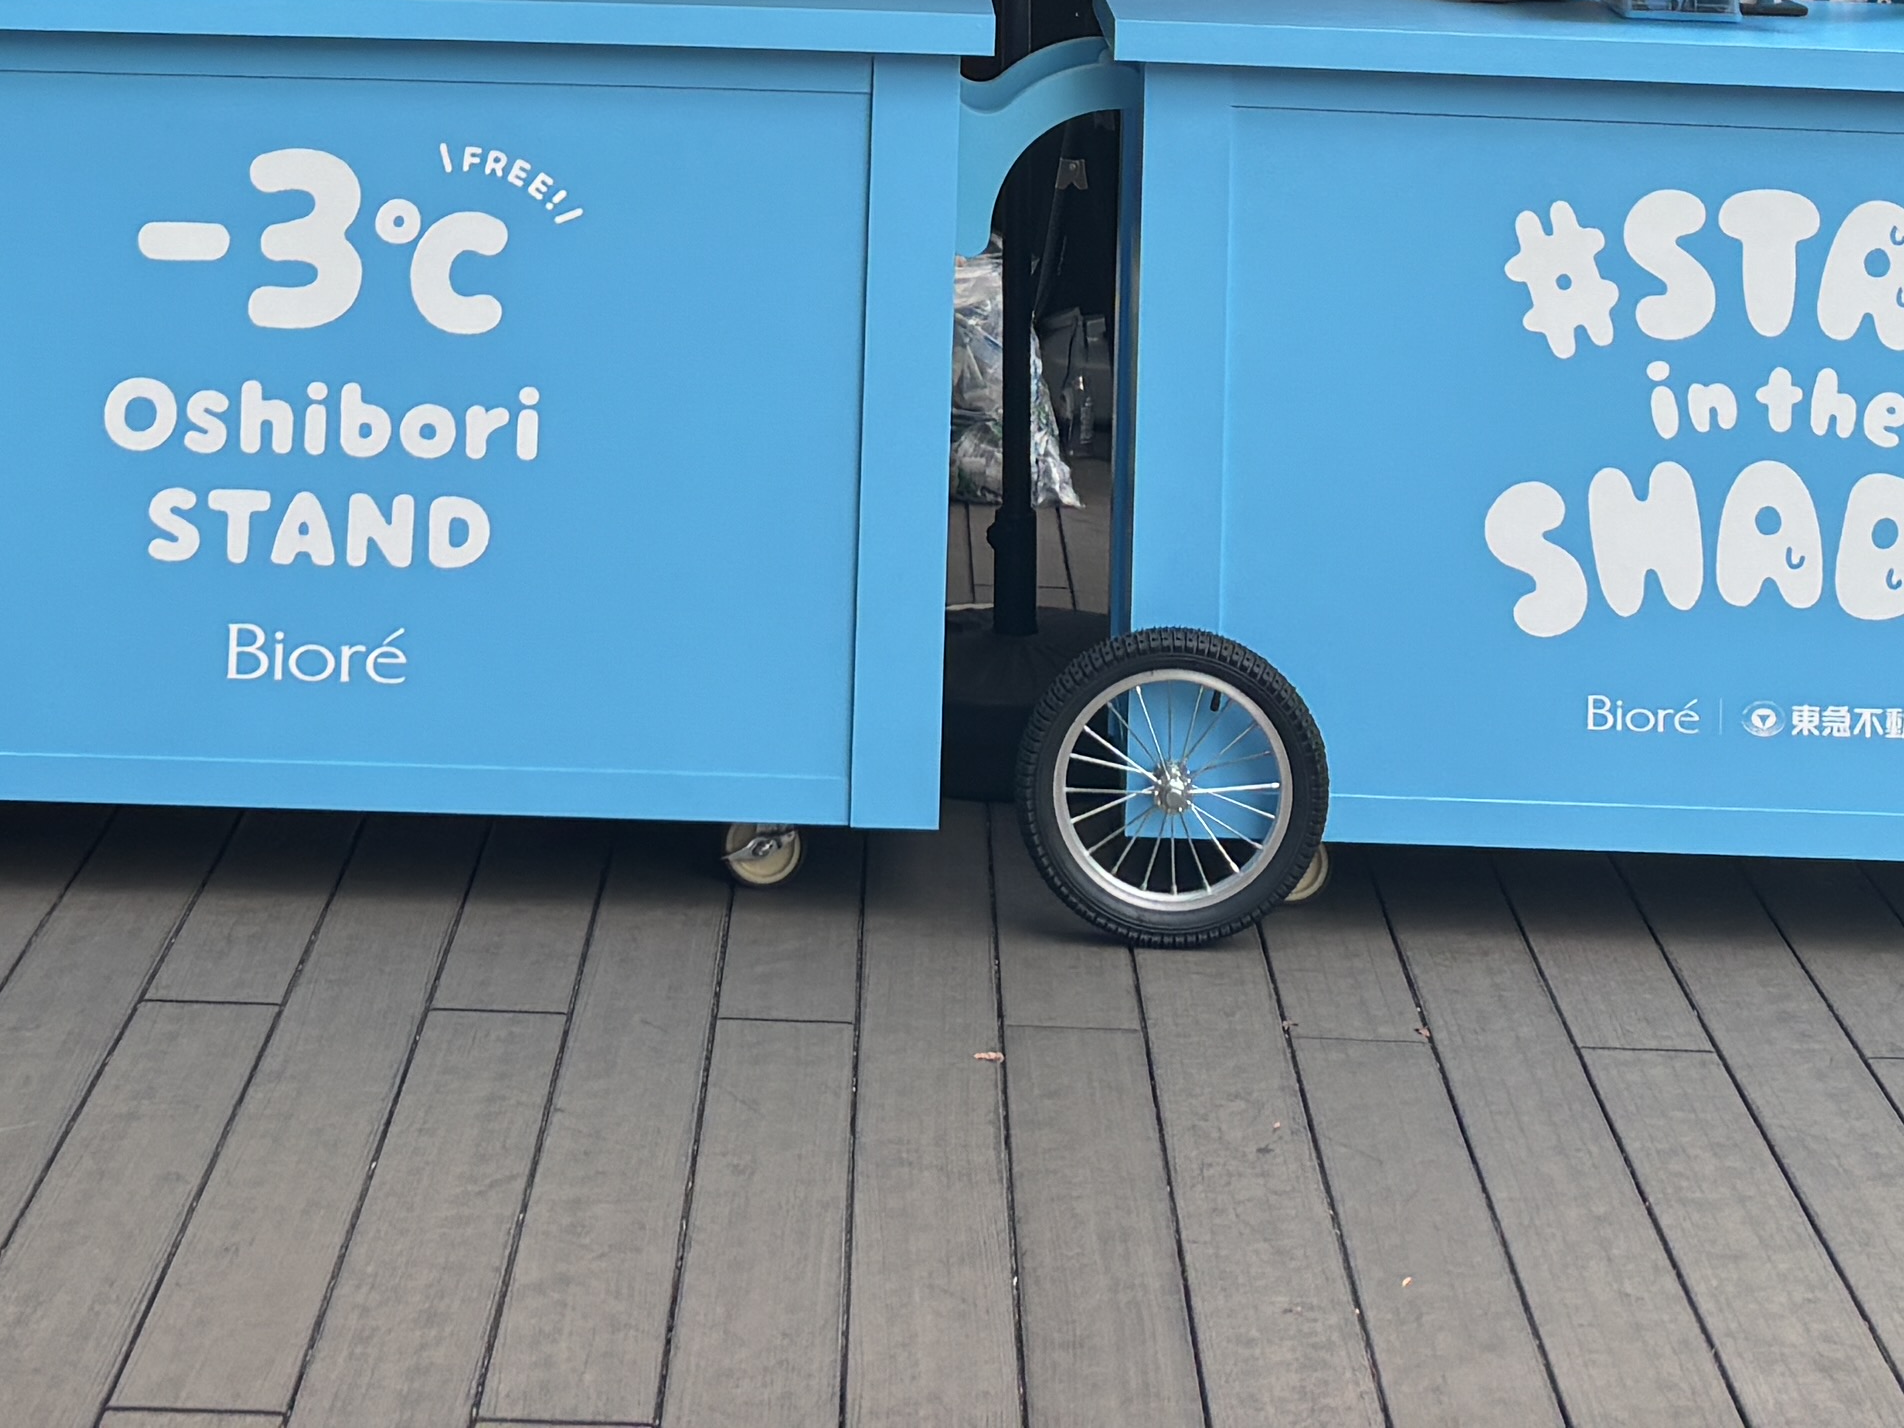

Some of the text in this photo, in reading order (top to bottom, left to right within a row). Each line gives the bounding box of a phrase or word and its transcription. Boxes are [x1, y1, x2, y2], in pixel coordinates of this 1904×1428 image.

[104, 377, 540, 461] Oshibori
[1646, 360, 1738, 439] in
[147, 487, 491, 569] STAND
[226, 623, 407, 684] Bioré
[1586, 695, 1701, 734] Bioré
